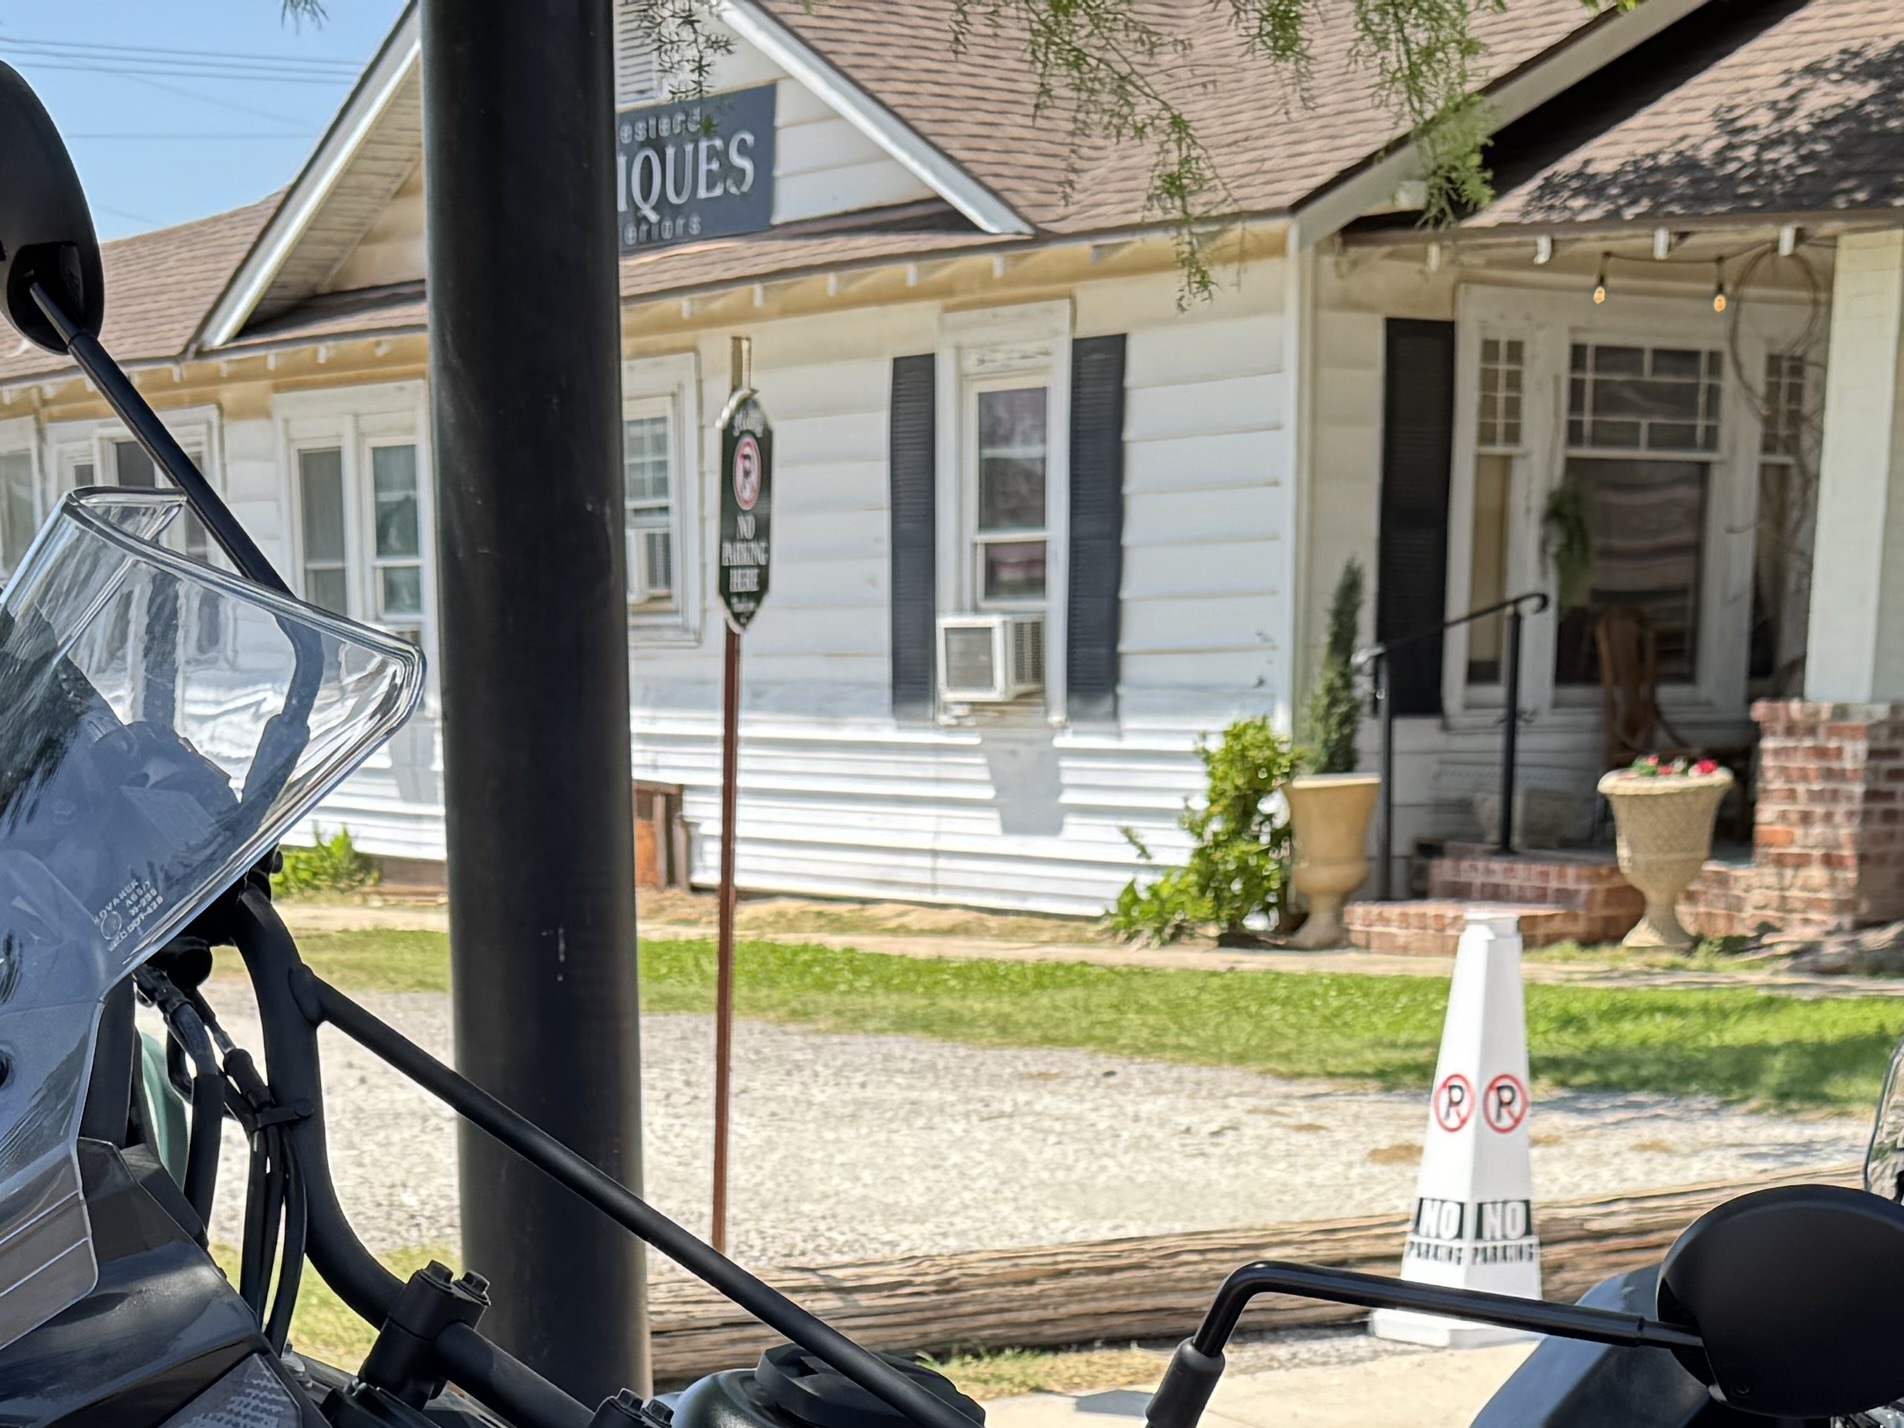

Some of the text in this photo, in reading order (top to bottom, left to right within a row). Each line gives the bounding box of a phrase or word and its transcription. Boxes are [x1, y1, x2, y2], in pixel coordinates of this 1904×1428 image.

[617, 131, 756, 224] IQUES
[623, 212, 702, 246] eriors
[1418, 1199, 1461, 1241] NO
[1482, 1201, 1526, 1241] NO
